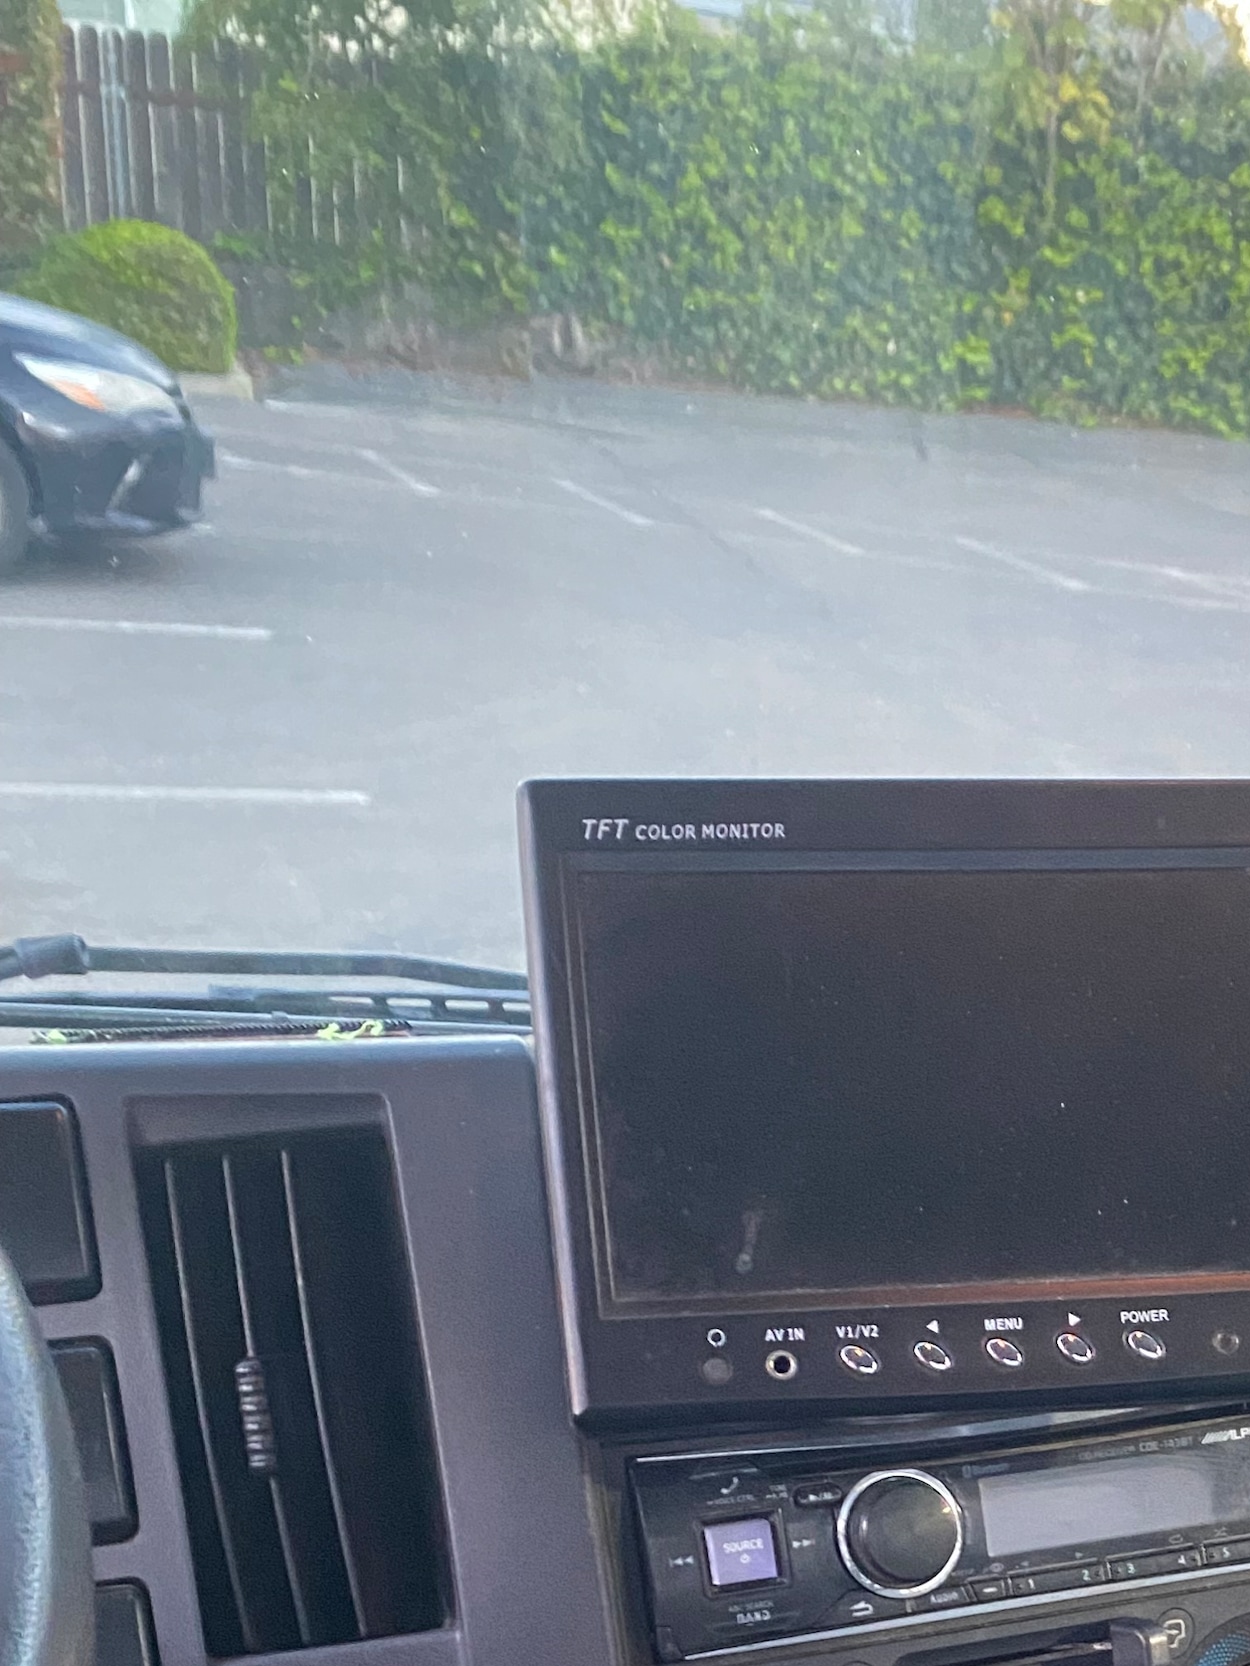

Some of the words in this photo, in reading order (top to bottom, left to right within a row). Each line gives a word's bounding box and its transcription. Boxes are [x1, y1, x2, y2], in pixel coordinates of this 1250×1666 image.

[582, 818, 629, 840] TFT
[635, 824, 696, 840] COLOR
[701, 822, 786, 839] MONITOR
[984, 1316, 1023, 1331] MENU
[1120, 1308, 1170, 1324] POWER
[835, 1324, 880, 1339] V1/V2
[723, 1537, 764, 1554] SOURCE
[1081, 1569, 1091, 1581] 2
